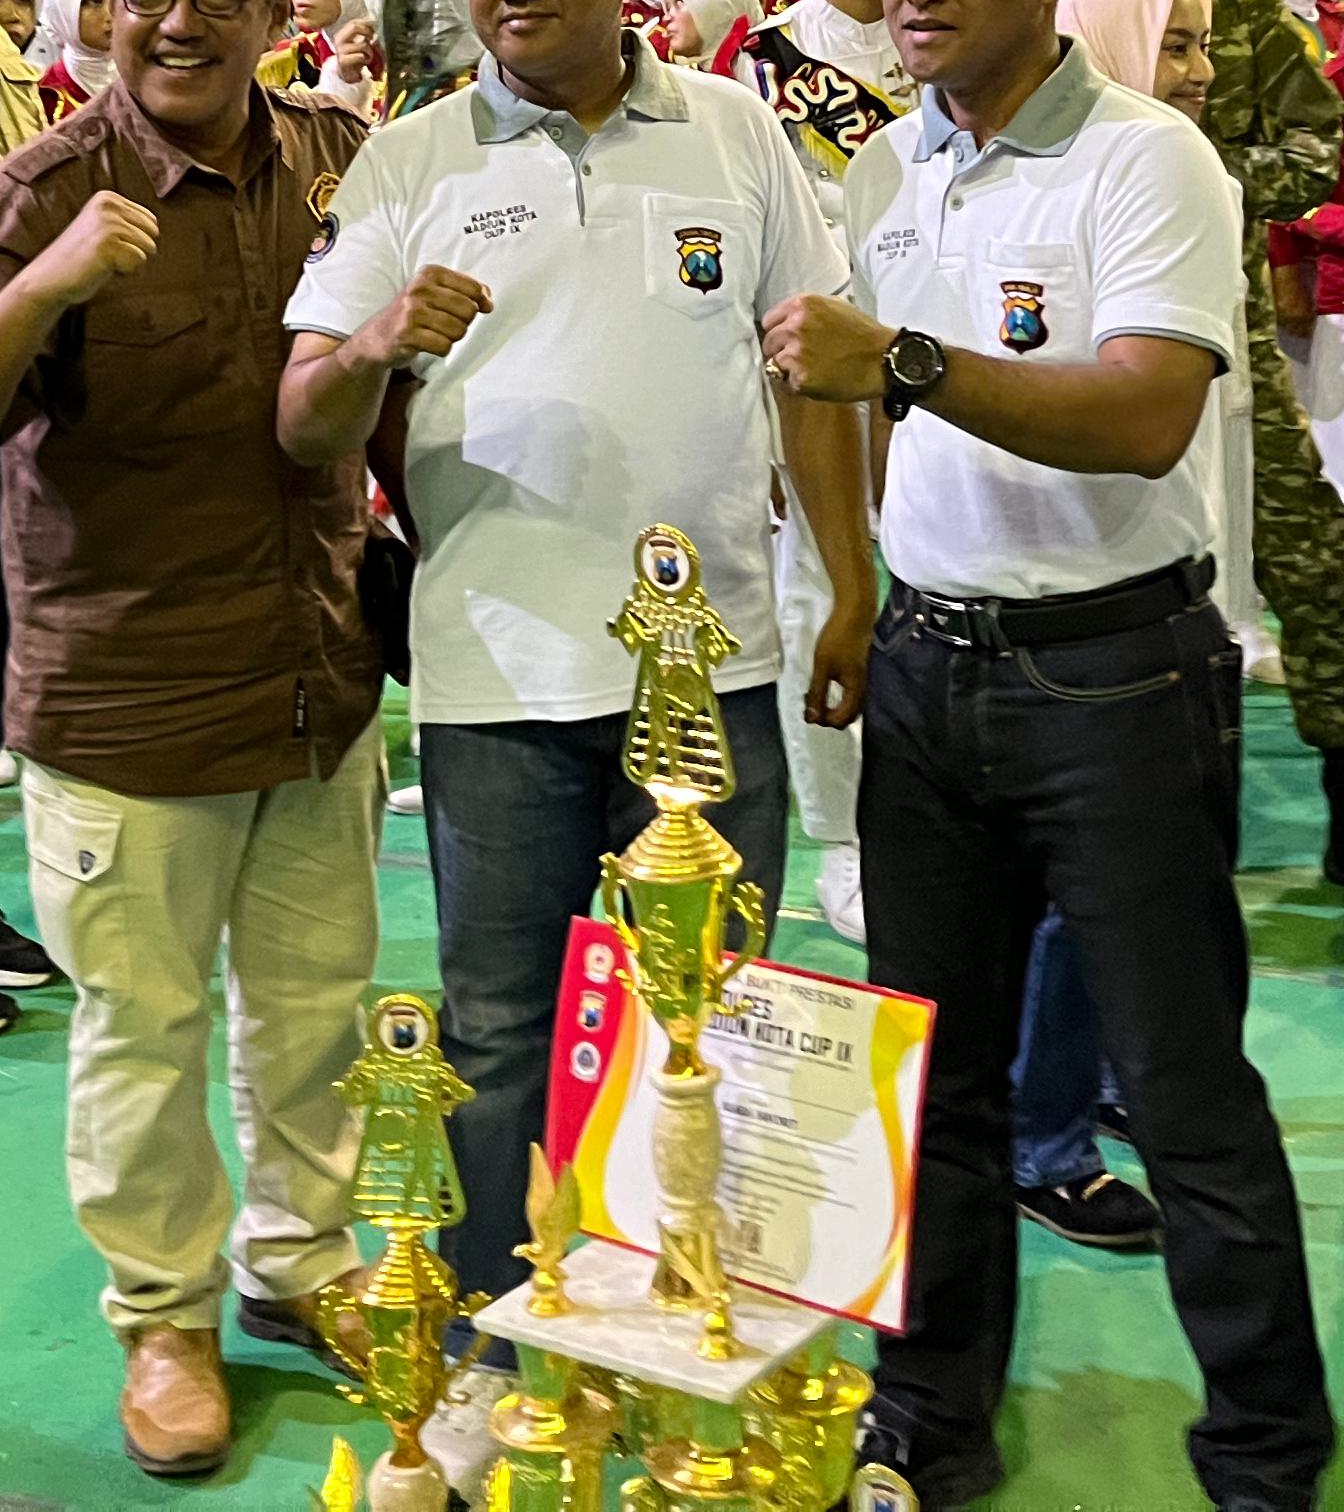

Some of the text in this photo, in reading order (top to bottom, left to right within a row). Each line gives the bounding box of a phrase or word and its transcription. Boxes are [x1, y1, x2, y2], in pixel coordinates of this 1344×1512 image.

[511, 211, 537, 223] KOTA
[484, 228, 505, 239] CUP
[756, 1022, 794, 1048] KOTA
[800, 1032, 833, 1057] CUP
